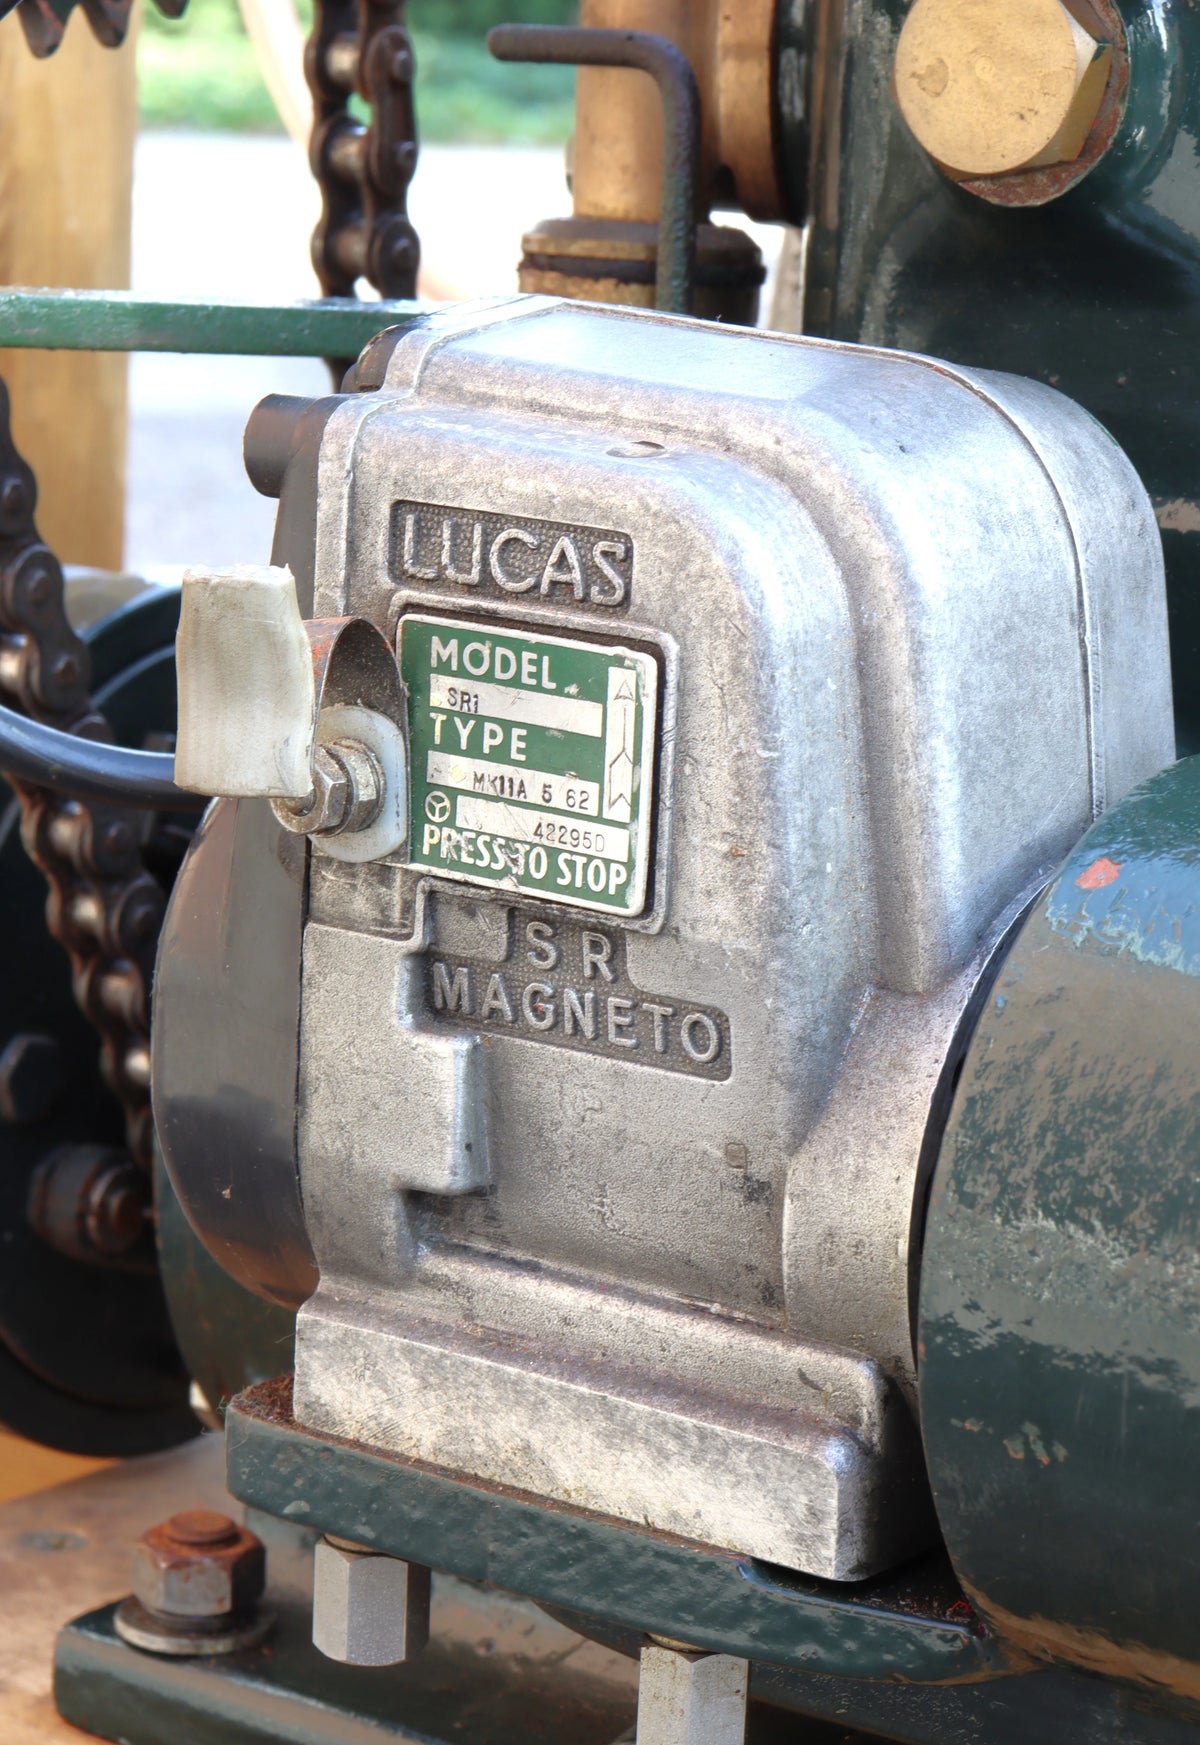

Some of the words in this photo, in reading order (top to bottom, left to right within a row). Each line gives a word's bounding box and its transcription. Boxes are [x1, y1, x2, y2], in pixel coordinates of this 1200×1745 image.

[404, 512, 628, 606] LUCAS
[430, 635, 557, 690] MODEL
[447, 687, 479, 714] SR1
[429, 712, 527, 762] TYPE
[566, 788, 590, 811] 62
[422, 823, 506, 871] PRESS
[507, 842, 548, 880] TO
[556, 852, 628, 896] STOP
[433, 961, 723, 1063] MAGNETO
